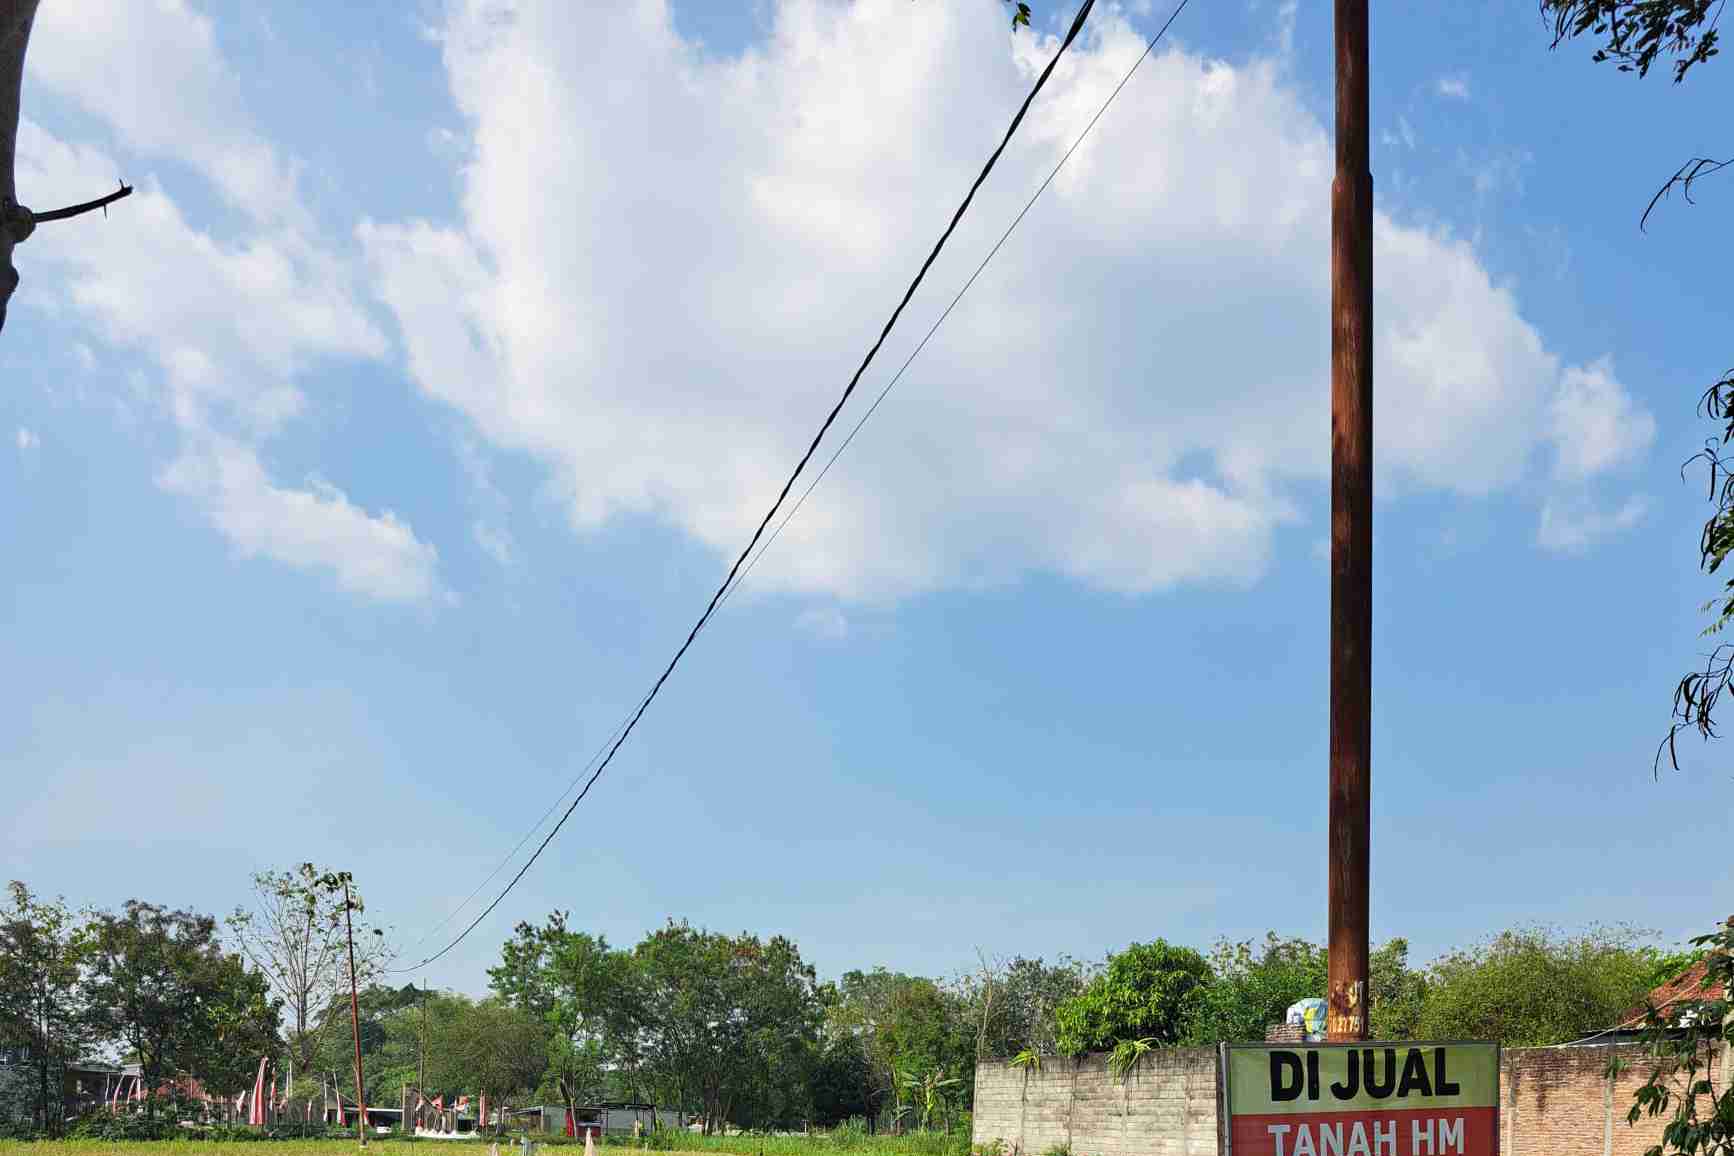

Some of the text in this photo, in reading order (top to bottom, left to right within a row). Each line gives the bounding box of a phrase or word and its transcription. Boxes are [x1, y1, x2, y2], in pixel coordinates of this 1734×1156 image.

[1269, 1047, 1460, 1101] DI JUAL
[1411, 1117, 1465, 1156] HM
